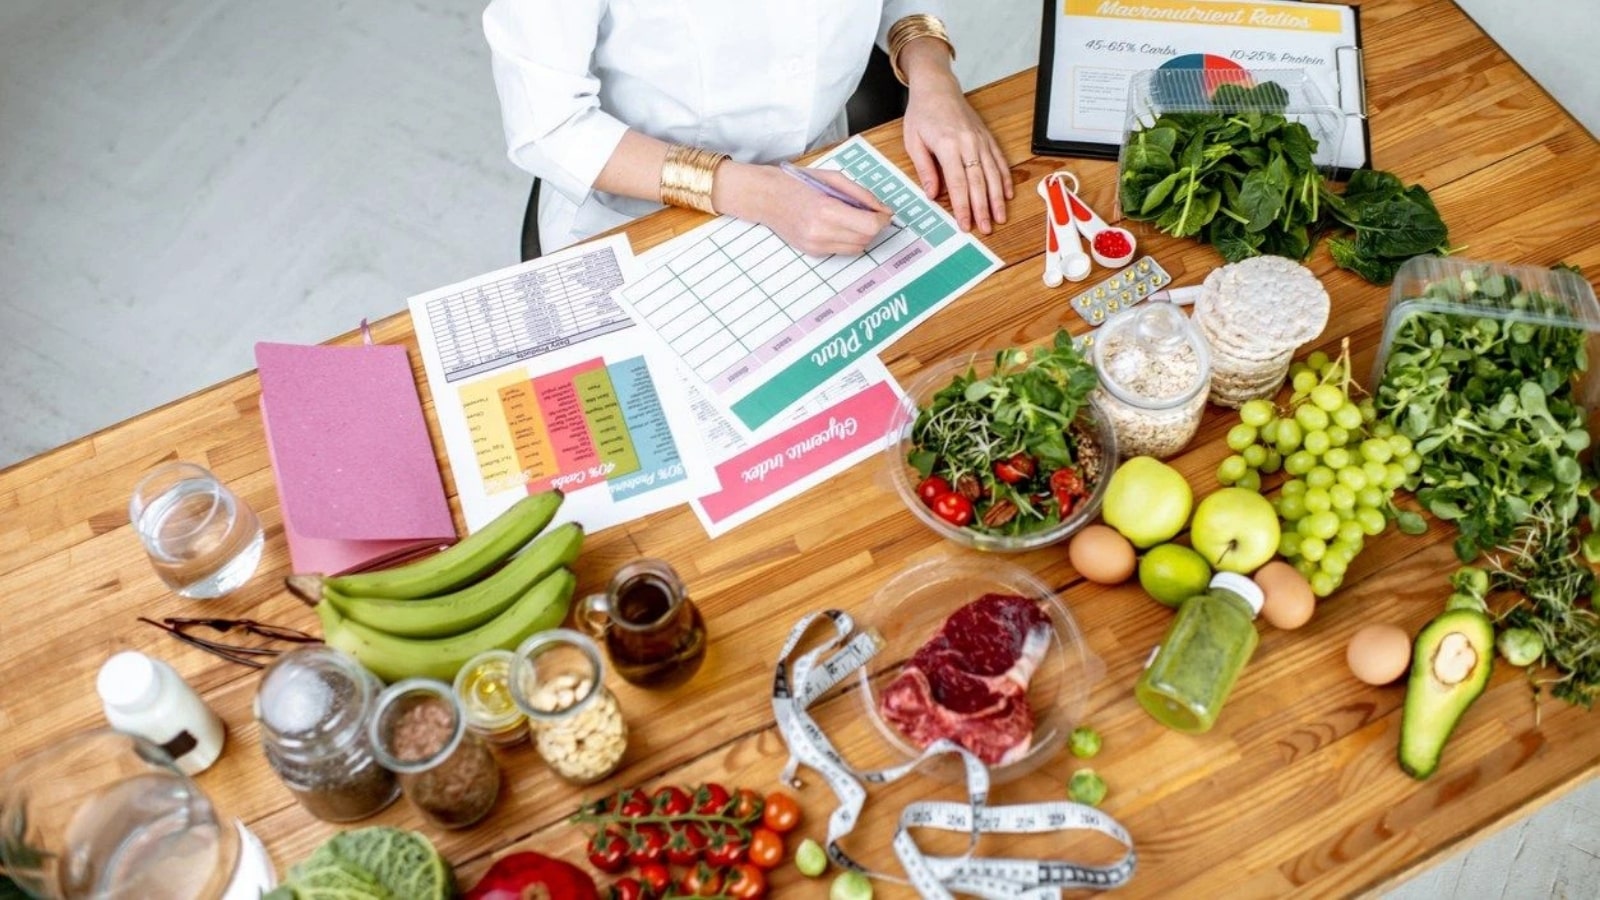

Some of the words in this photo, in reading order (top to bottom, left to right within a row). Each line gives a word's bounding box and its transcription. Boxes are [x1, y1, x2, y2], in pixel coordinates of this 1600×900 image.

[1096, 1, 1243, 25] Macronutrient
[1248, 8, 1311, 28] Ratios
[1085, 39, 1136, 53] 45-65%
[1140, 43, 1177, 57] Carbs
[1229, 49, 1277, 62] 10-25%
[1280, 52, 1325, 66] Protein
[859, 294, 908, 341] Meal
[811, 326, 862, 367] Plan
[785, 416, 858, 459] Glycemic
[588, 462, 616, 478] 40%
[657, 464, 684, 480] 30%
[741, 453, 784, 482] index
[551, 471, 587, 488] Carbs
